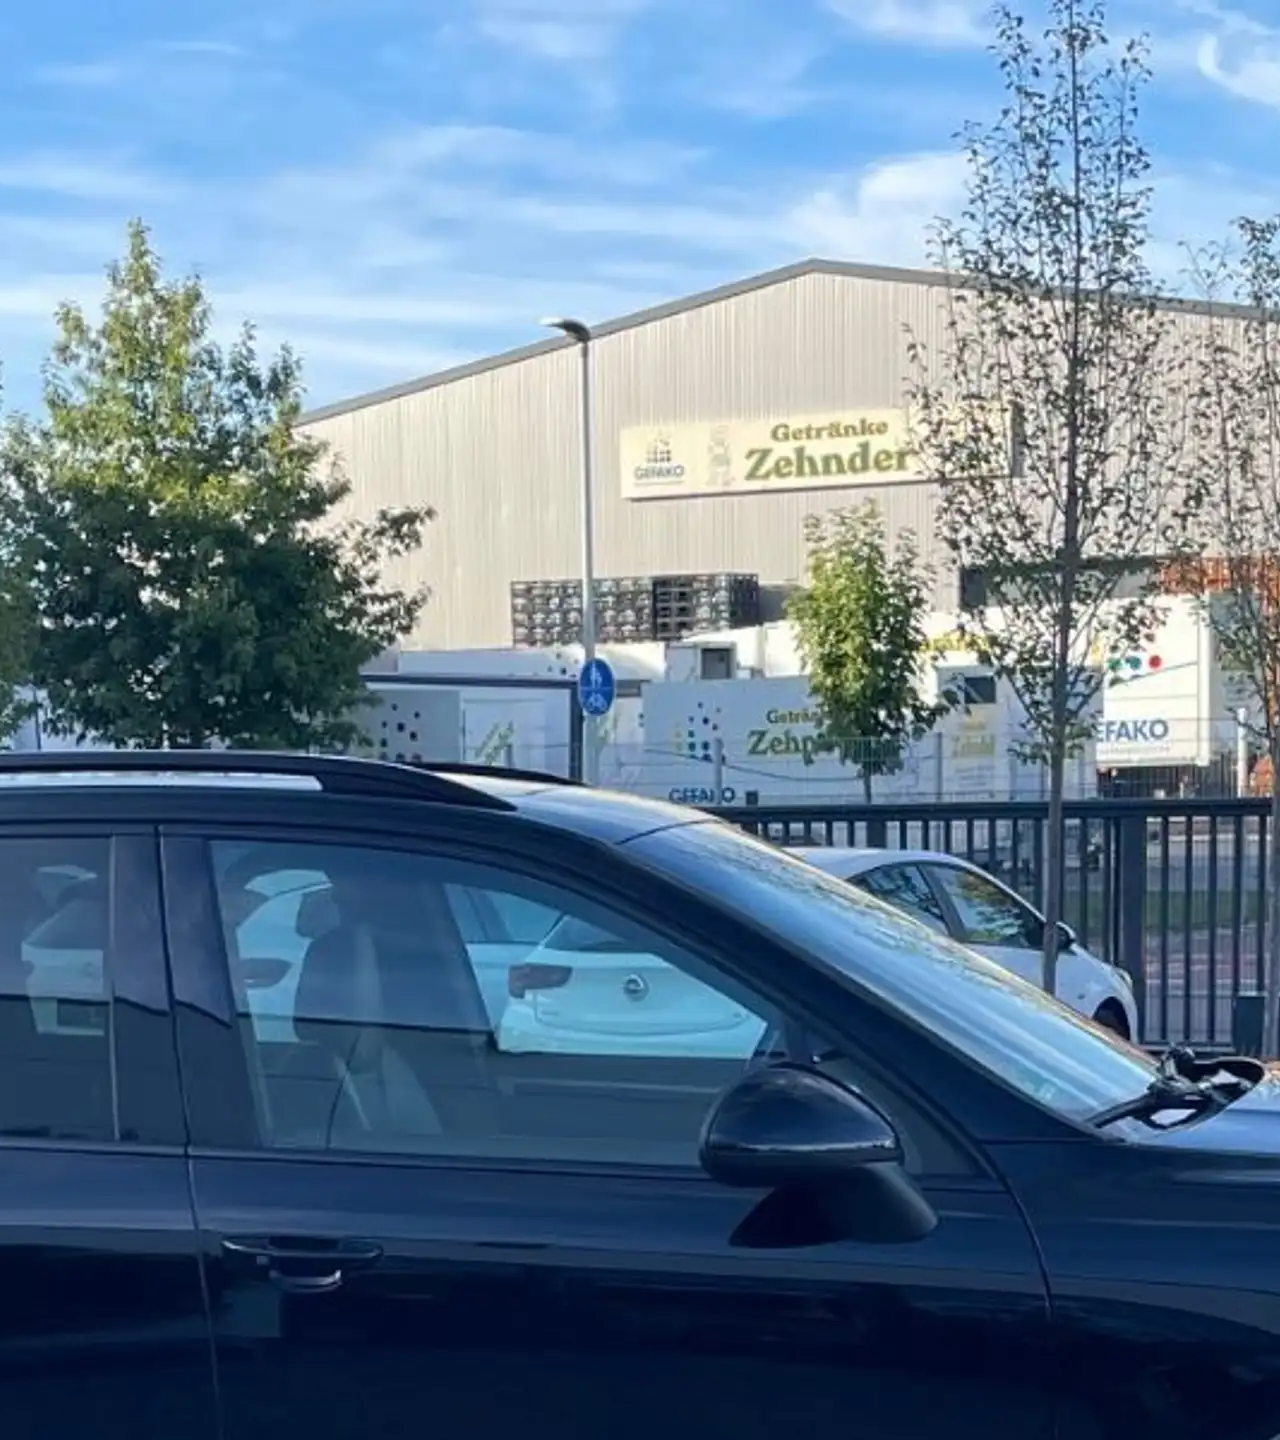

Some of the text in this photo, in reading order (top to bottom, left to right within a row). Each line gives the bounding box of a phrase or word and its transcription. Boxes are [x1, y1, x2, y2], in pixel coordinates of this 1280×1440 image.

[770, 418, 890, 444] Getränke
[744, 441, 914, 482] Zehnder
[1095, 718, 1169, 742] EFAKO
[668, 786, 736, 803] GEFAO
